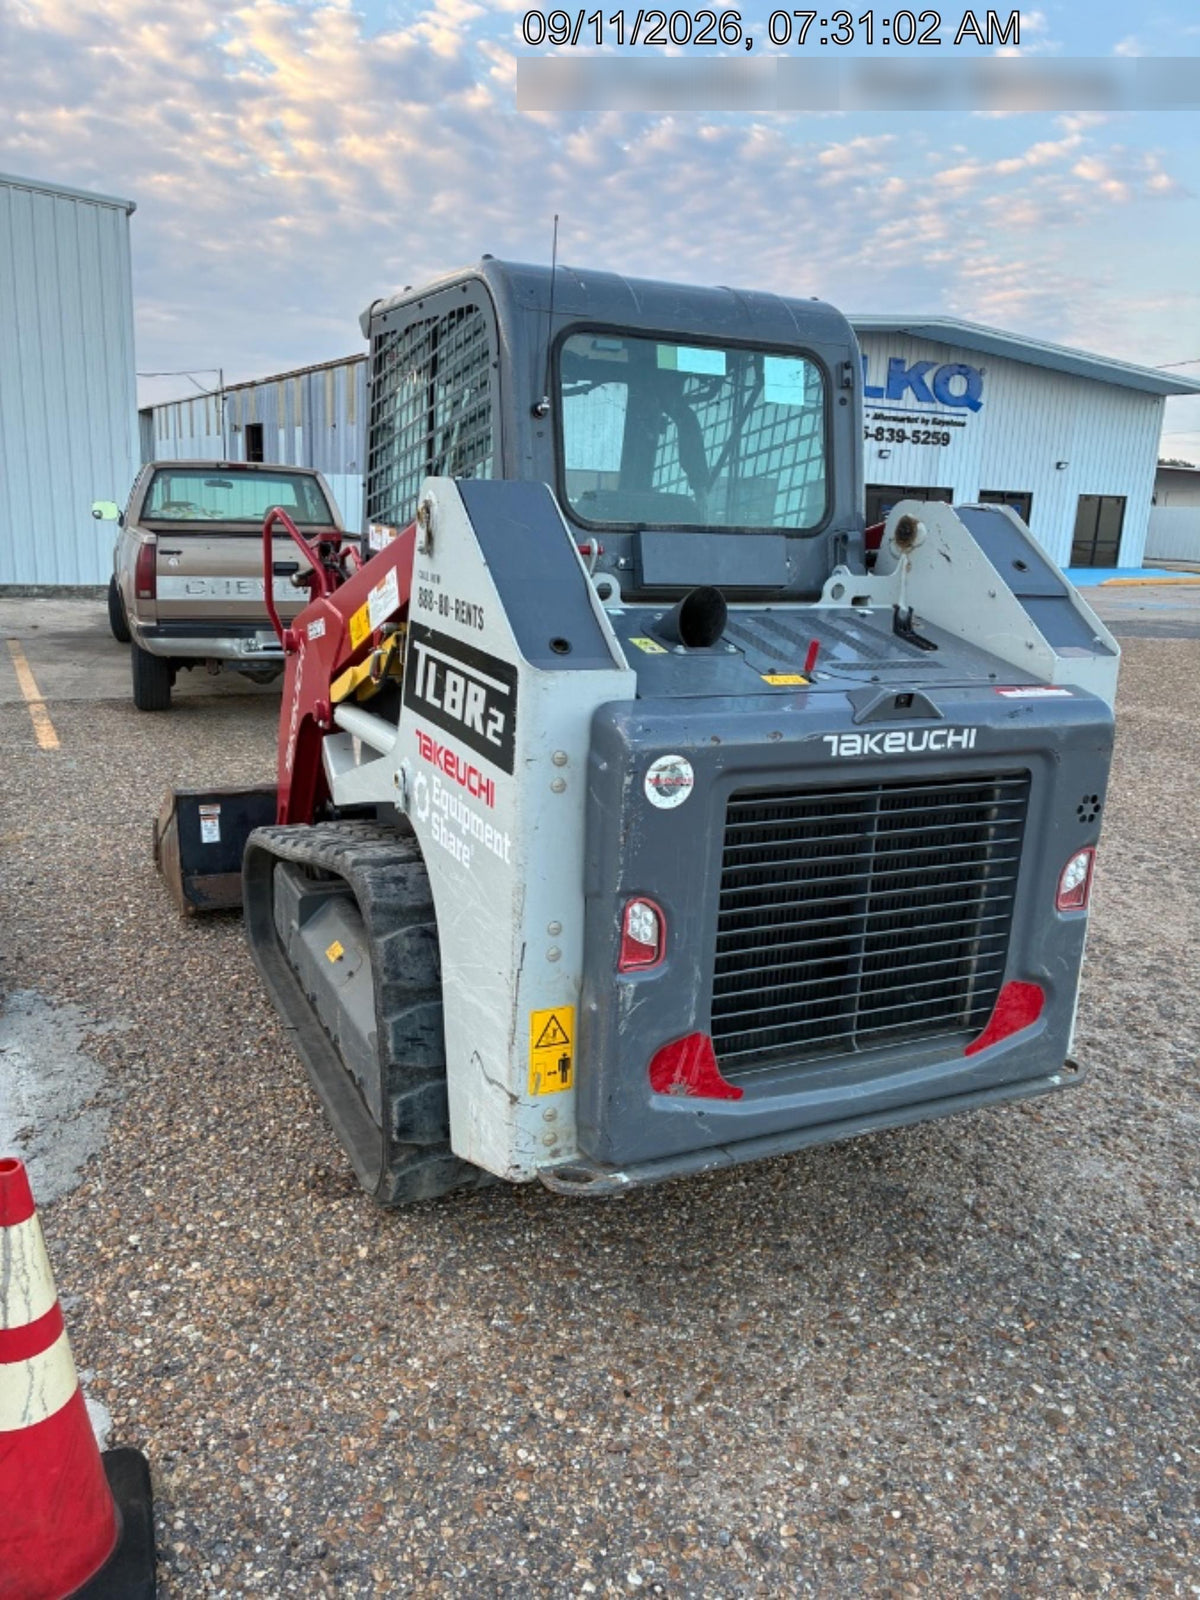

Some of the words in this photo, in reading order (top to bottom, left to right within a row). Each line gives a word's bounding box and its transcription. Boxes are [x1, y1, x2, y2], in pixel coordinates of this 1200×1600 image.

[862, 354, 983, 413] LKQ
[415, 729, 495, 809] TAKEUCHI
[823, 727, 977, 757] TAKEUCHI
[431, 774, 512, 865] Equipment
[431, 811, 471, 869] Share
